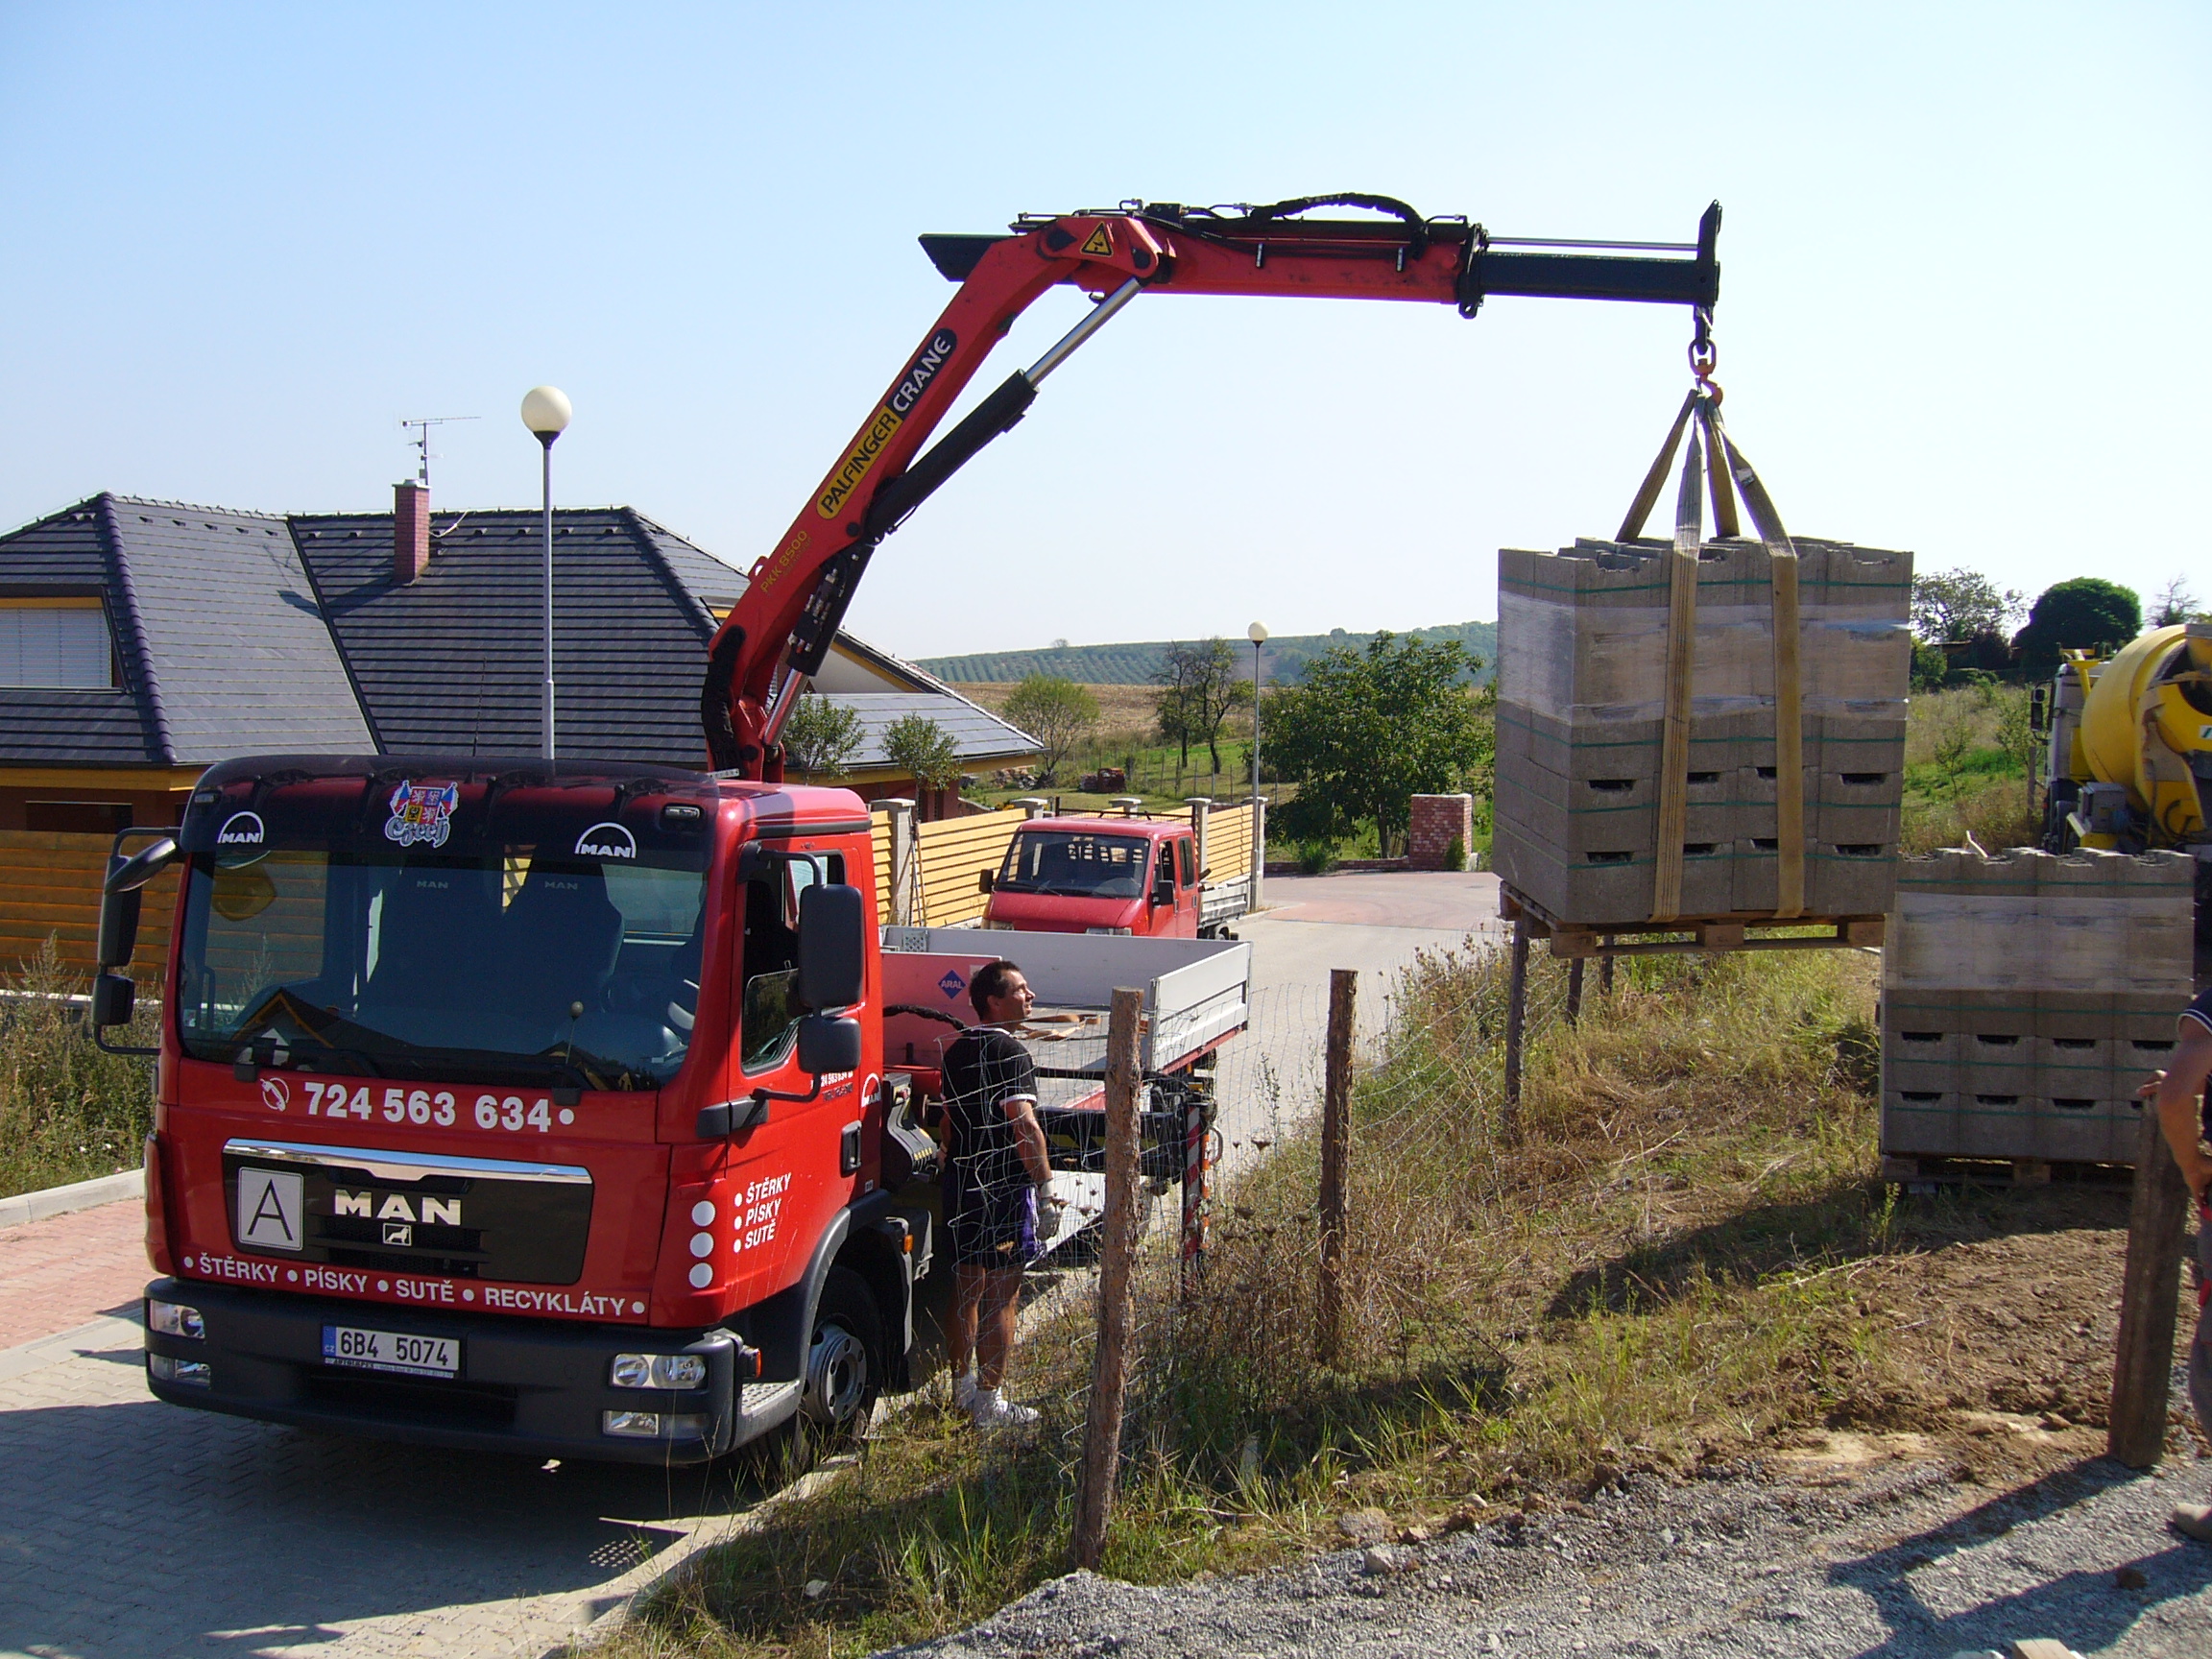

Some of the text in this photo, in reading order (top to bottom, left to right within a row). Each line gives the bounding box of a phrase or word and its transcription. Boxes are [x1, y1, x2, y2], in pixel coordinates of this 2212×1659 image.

[821, 335, 951, 514] PALFINGER CRANE
[760, 565, 782, 593] PKK
[779, 530, 807, 567] 8500
[221, 832, 261, 844] MAN
[386, 816, 449, 848] Czech
[580, 843, 632, 858] MAN
[417, 880, 448, 889] MAN
[544, 880, 578, 890] MAN
[941, 979, 963, 989] ARAL
[304, 1082, 551, 1133] 724 563 634
[746, 1171, 792, 1204] ŠTĚRKY
[247, 1178, 294, 1241] A
[335, 1189, 461, 1226] MAN
[745, 1197, 781, 1227] PÍSKY
[745, 1217, 776, 1250] SUTĚ
[200, 1252, 626, 1316] ŠTĚRKY PÍSKY SUTĚ RECYKLÁTY
[325, 1344, 335, 1354] CZ
[340, 1331, 448, 1366] 6B4 5074
